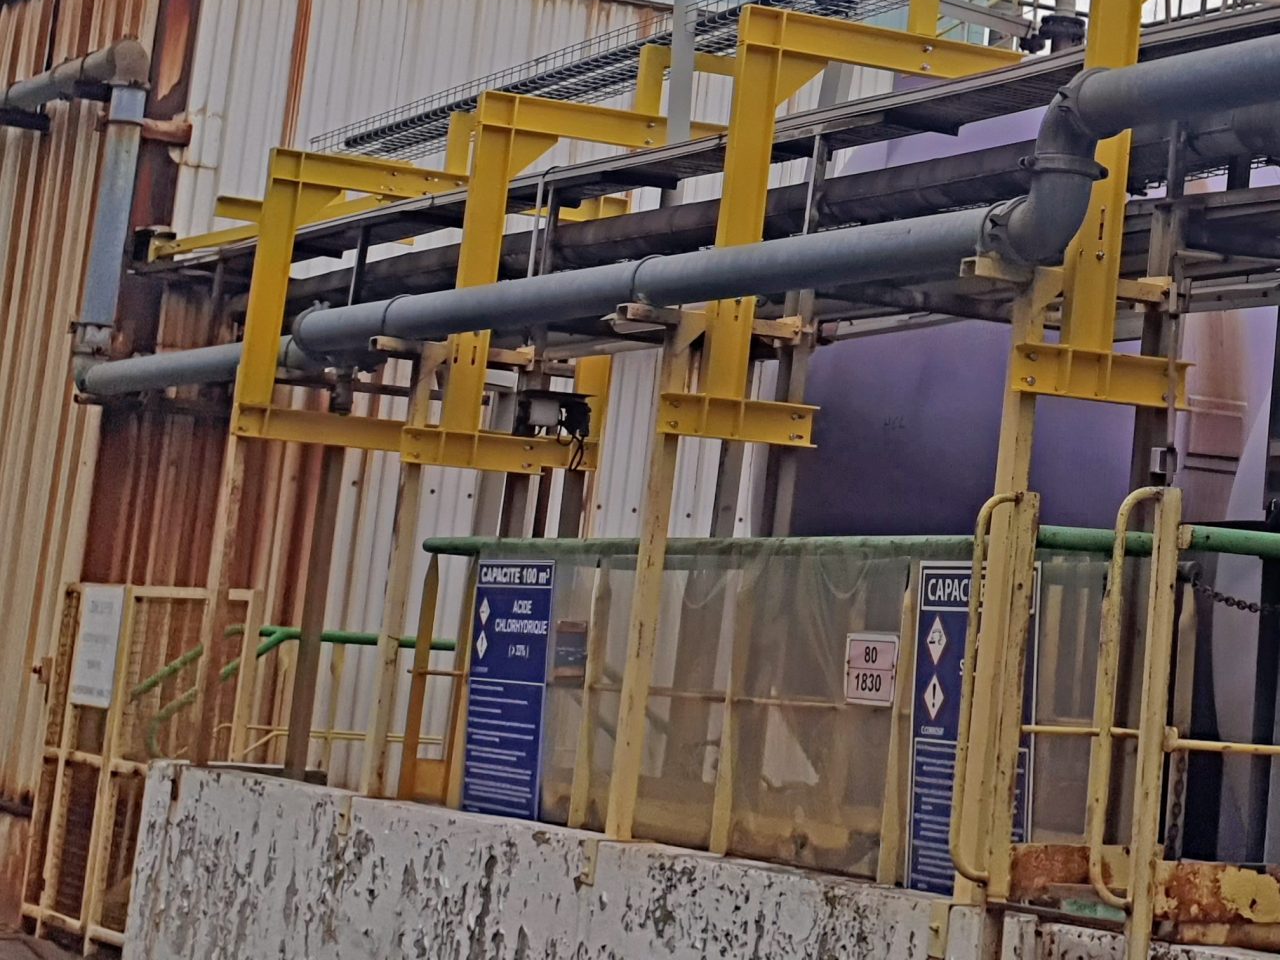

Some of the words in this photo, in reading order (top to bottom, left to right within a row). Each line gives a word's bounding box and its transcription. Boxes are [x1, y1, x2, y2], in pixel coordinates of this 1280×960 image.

[481, 567, 520, 583] CAPACITE
[522, 567, 537, 583] 100
[512, 600, 533, 614] ACIDE
[494, 619, 548, 634] CHLORHYDRIQUE
[864, 646, 878, 664] 80
[855, 672, 882, 693] 1830
